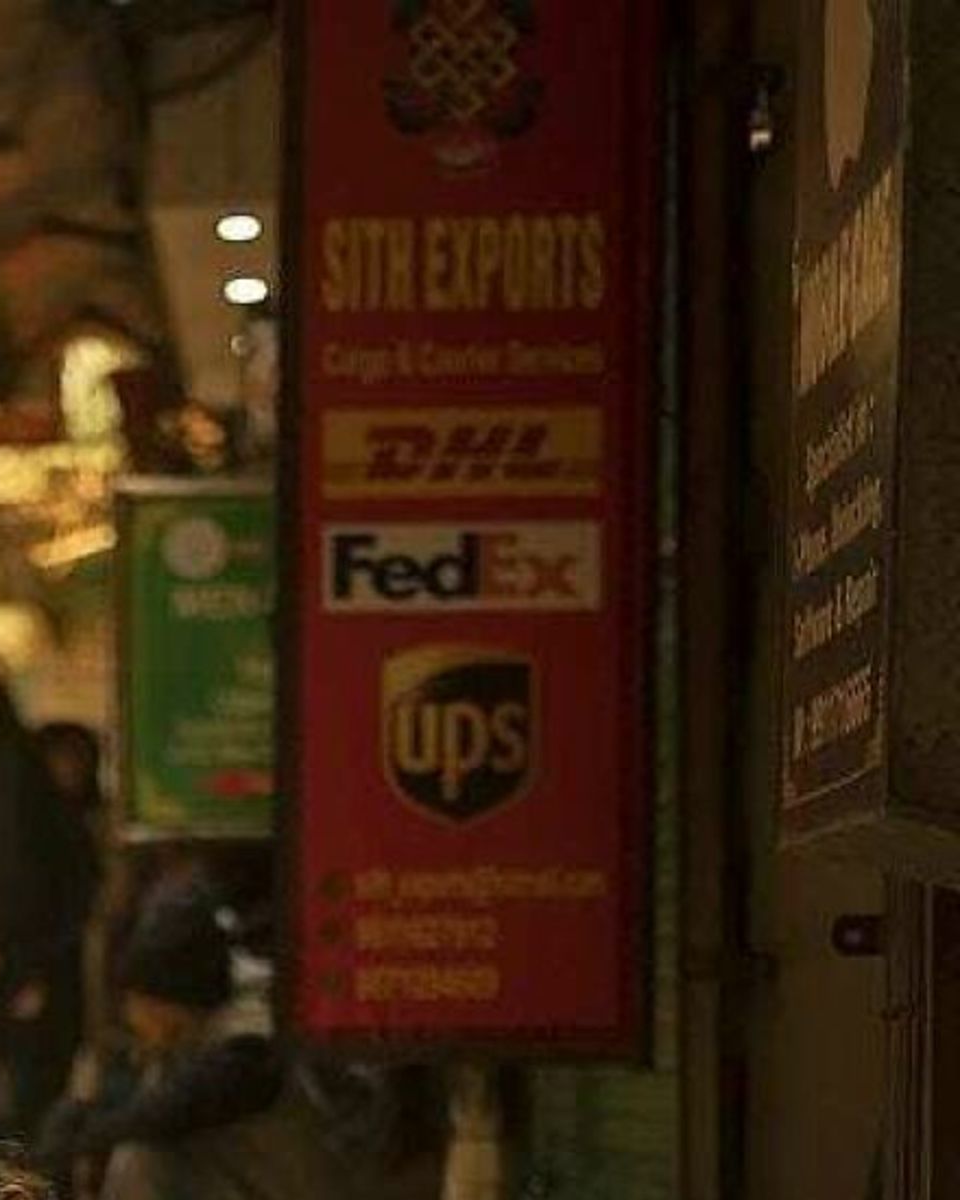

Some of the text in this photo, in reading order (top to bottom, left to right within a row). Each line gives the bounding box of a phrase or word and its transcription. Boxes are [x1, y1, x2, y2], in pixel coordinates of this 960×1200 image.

[424, 214, 603, 310] EXPORTS
[366, 425, 564, 480] DHL
[331, 534, 577, 600] FedEx
[396, 702, 527, 800] ups
